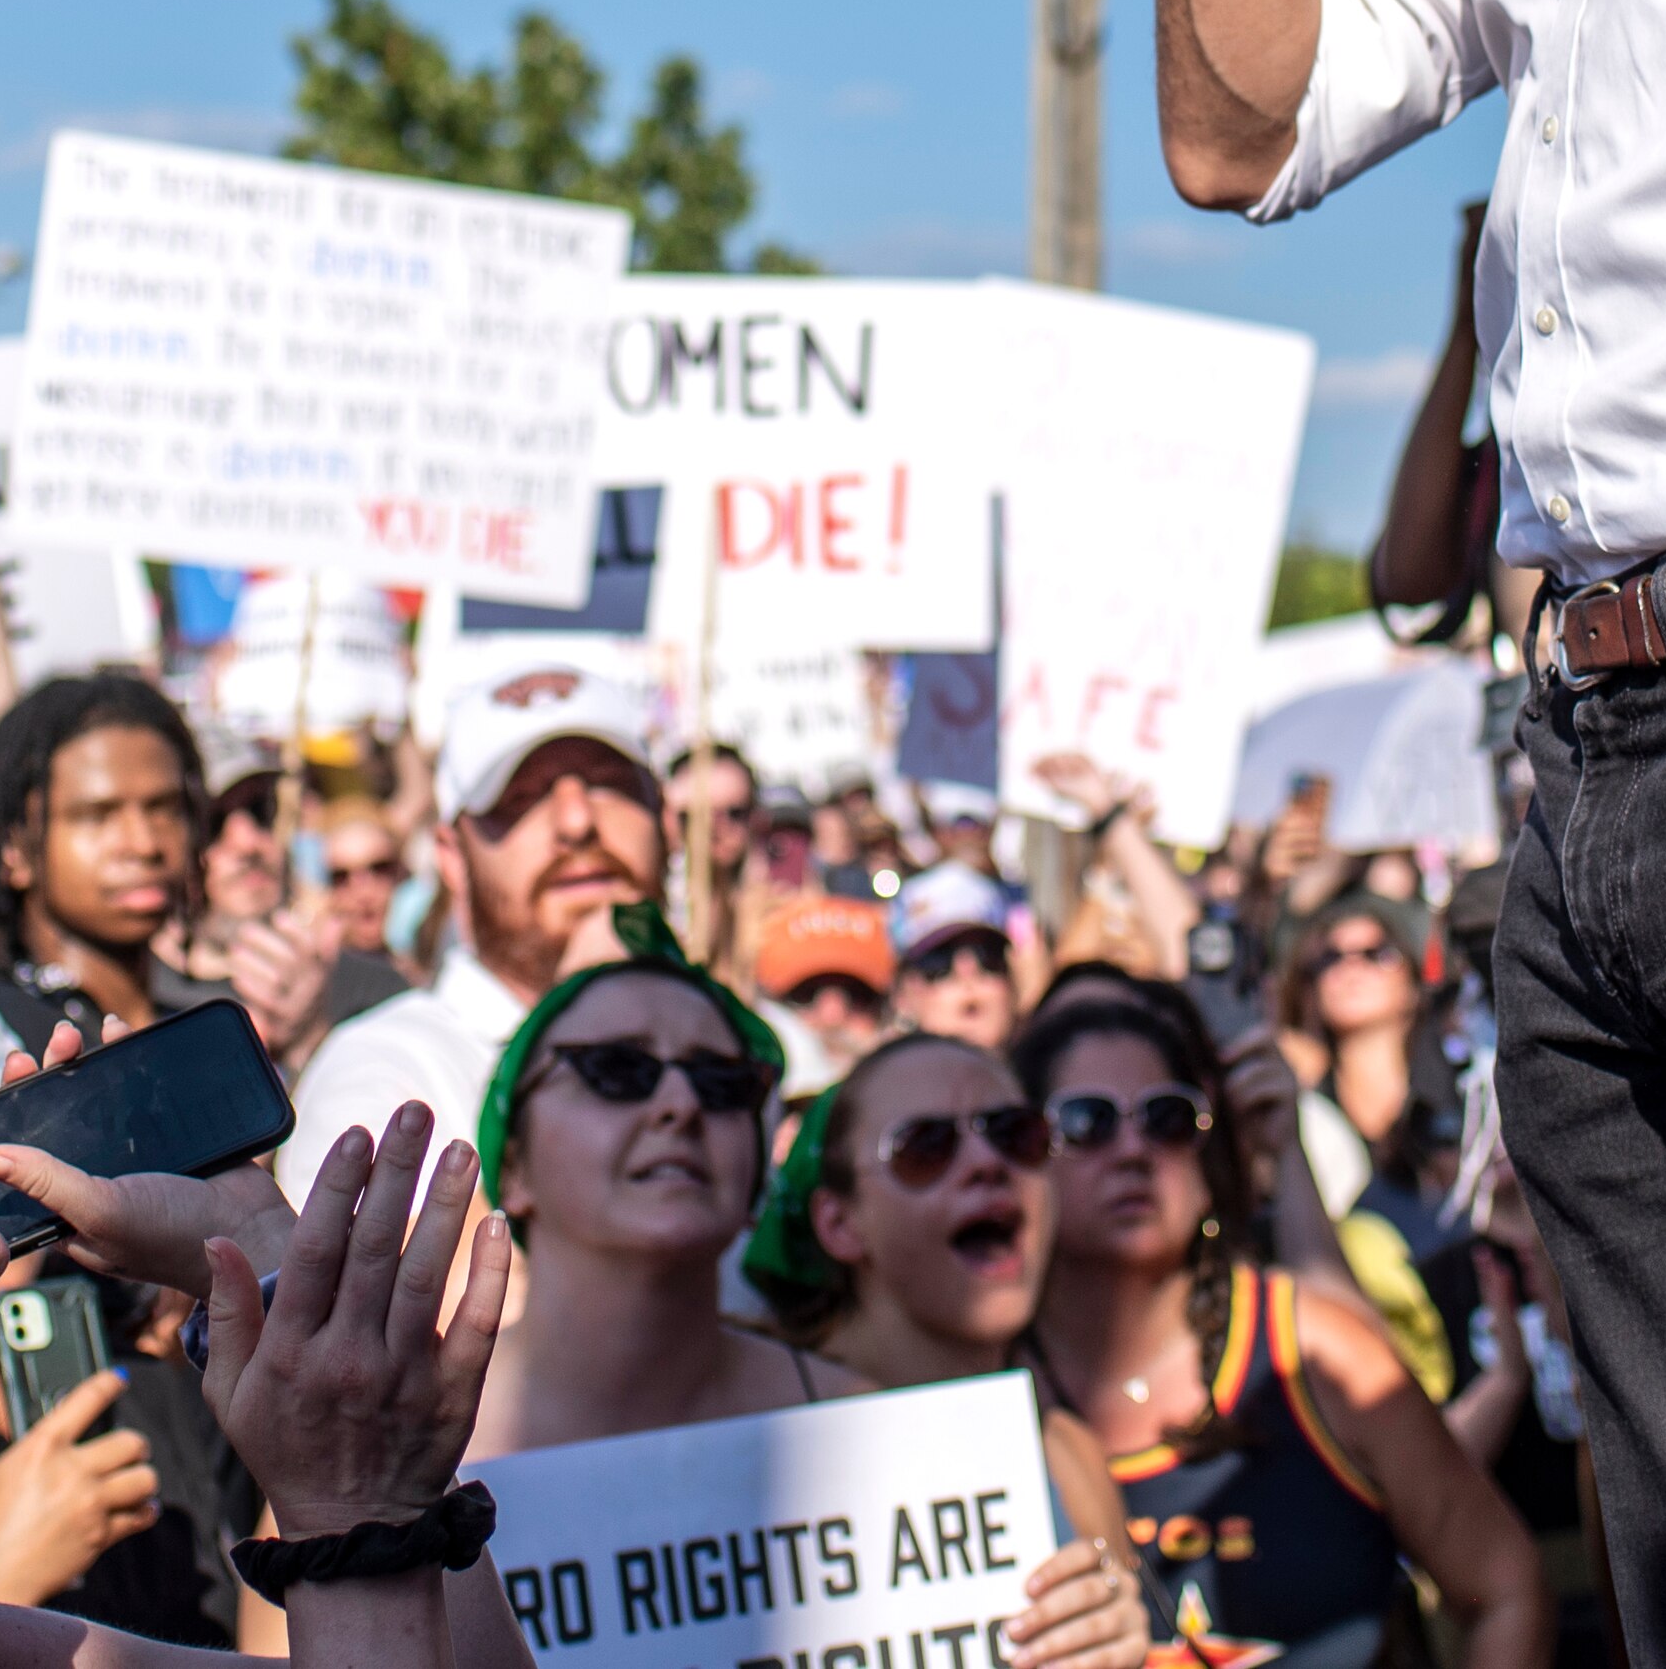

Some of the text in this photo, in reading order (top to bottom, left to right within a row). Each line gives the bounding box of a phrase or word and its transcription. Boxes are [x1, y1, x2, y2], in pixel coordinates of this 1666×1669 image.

[605, 313, 875, 419] OMEN
[355, 494, 453, 558] YOU
[715, 461, 909, 577] DIE!
[615, 1517, 859, 1636] RIGHTS
[889, 1489, 1018, 1591] ARE
